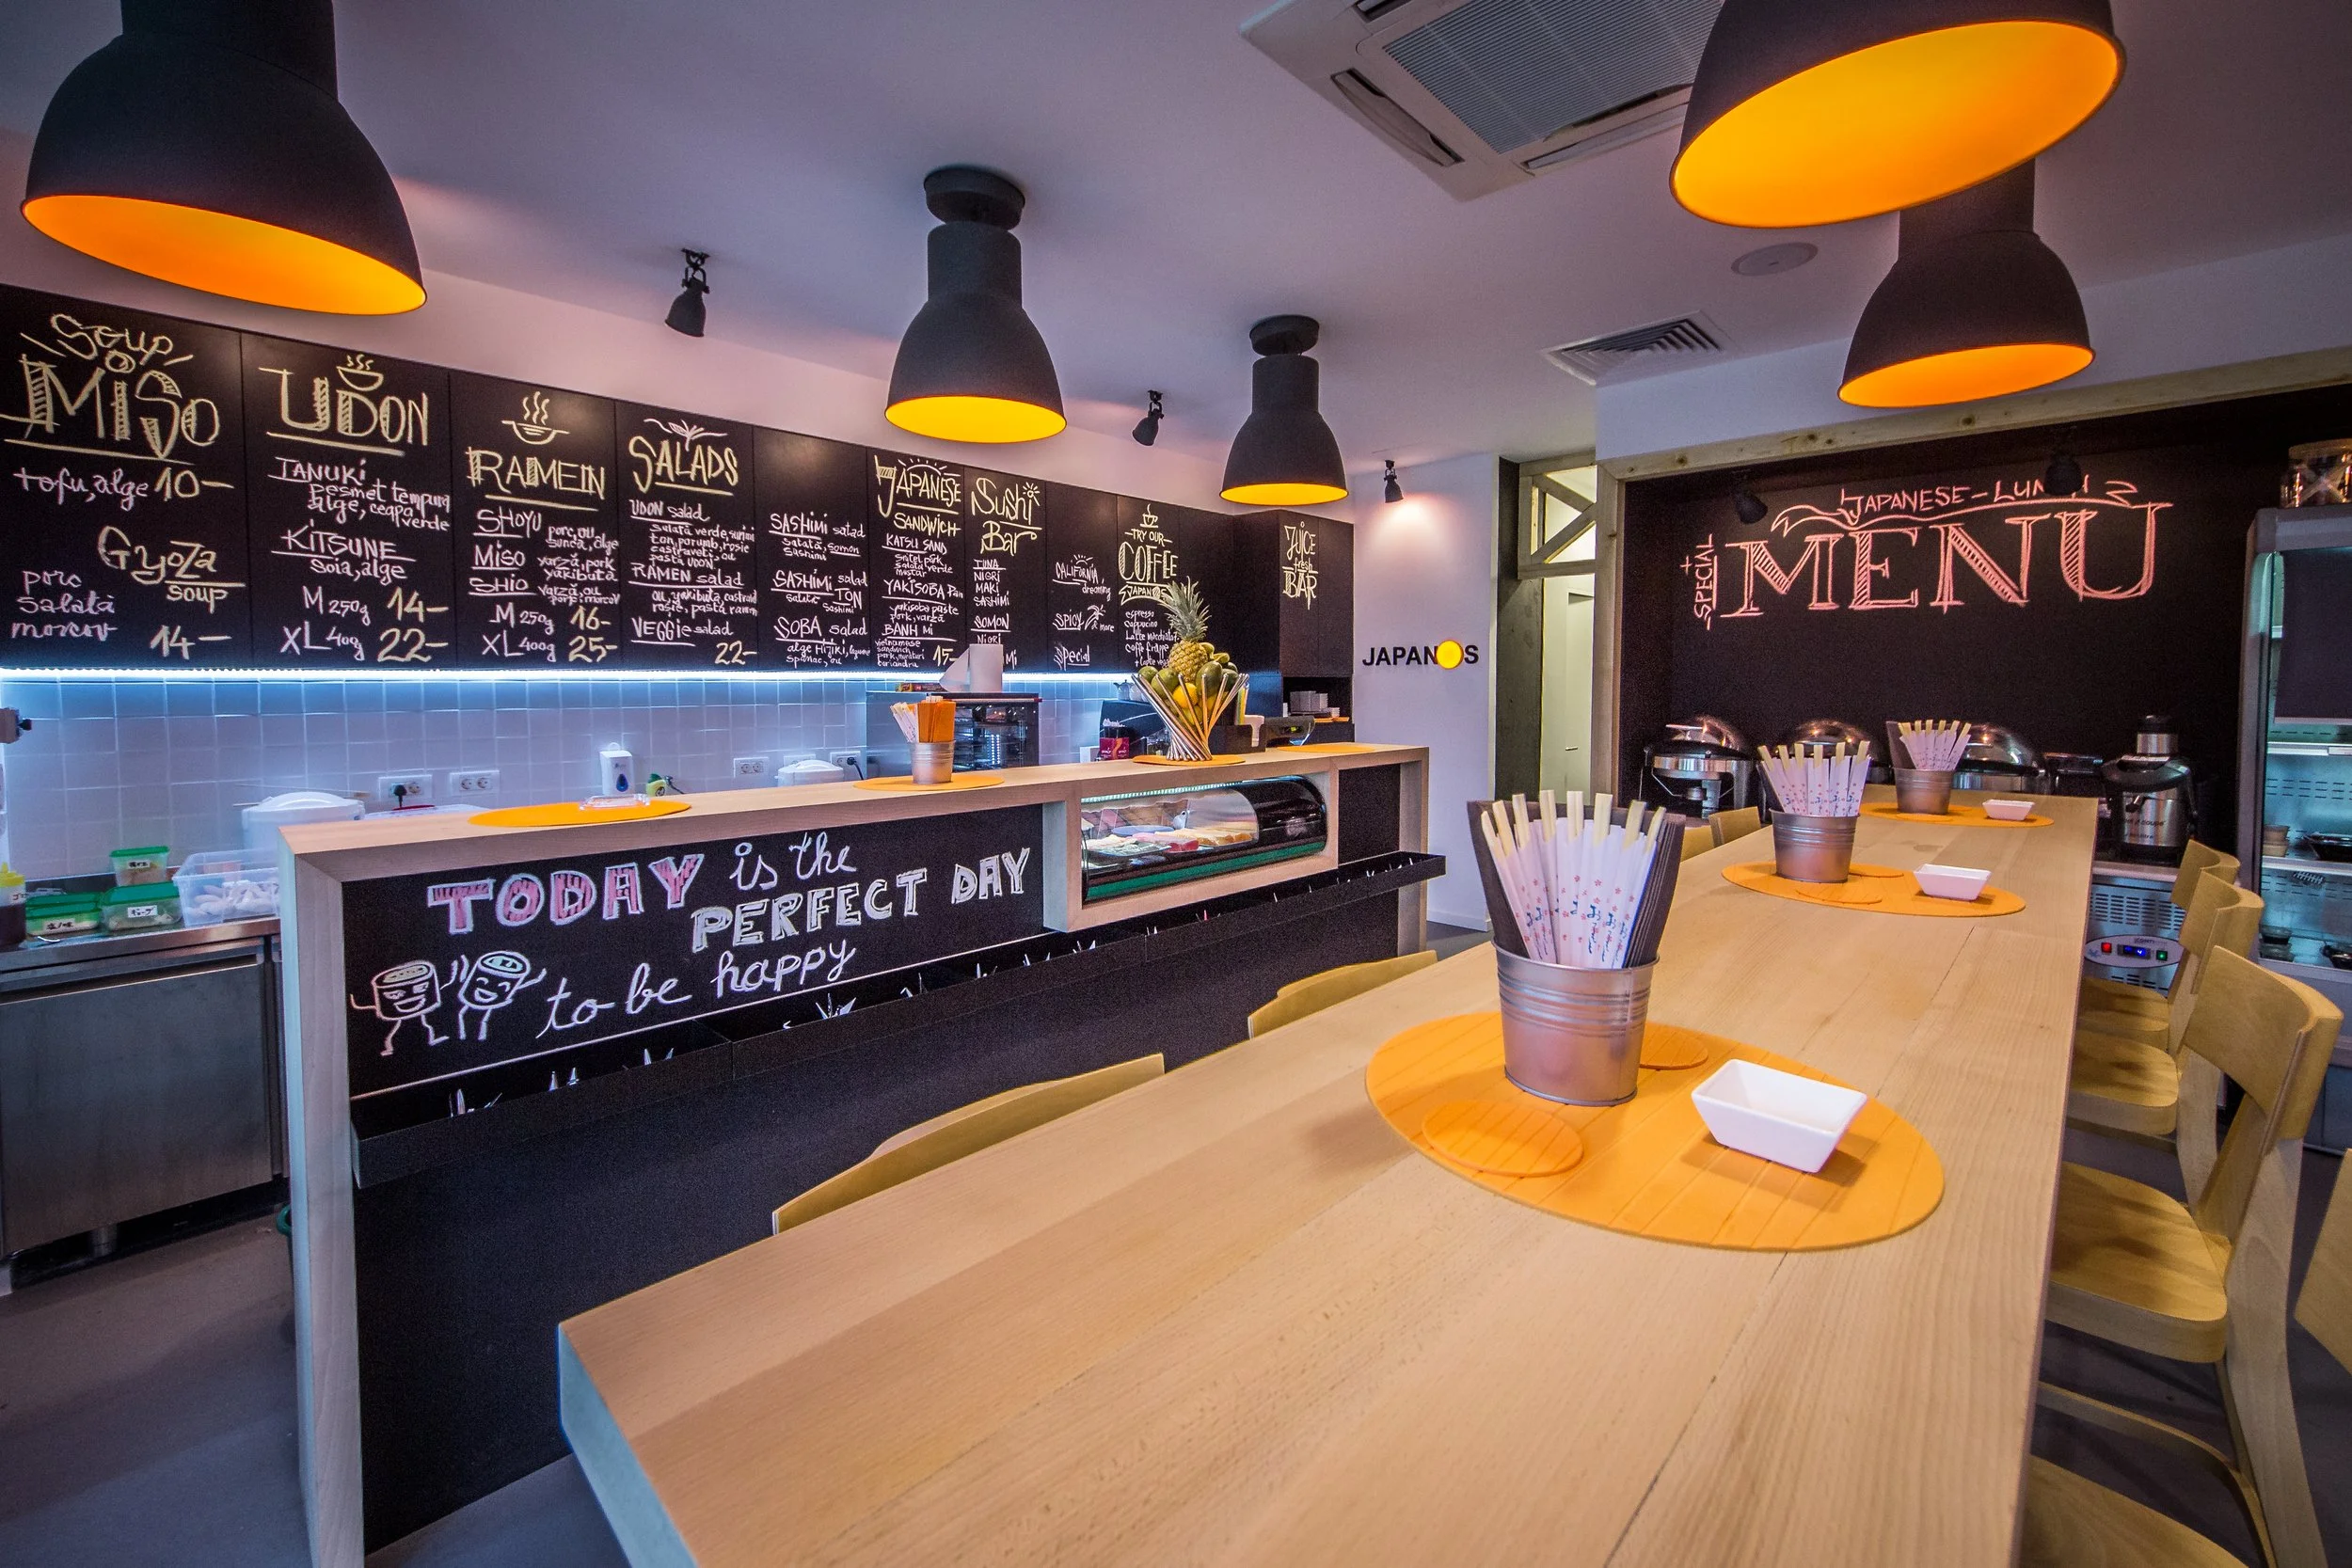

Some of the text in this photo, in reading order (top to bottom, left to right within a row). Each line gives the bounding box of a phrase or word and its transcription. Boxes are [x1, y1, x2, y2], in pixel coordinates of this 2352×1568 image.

[259, 368, 429, 446] UDON
[628, 436, 739, 494] SALADS
[874, 455, 961, 518] JAPANESE
[886, 532, 947, 555] KATSU SAND
[1119, 541, 1178, 583] COFFEE
[1721, 501, 2173, 617] MENU
[302, 586, 325, 614] M
[1282, 570, 1317, 610] BAR
[490, 602, 515, 628] M
[773, 616, 823, 639] SOBA
[882, 622, 918, 637] BANH
[280, 621, 332, 655] XL
[482, 629, 524, 657] XL
[427, 832, 858, 936] TODAY is the
[691, 847, 1031, 954] PERFECT DAY
[535, 939, 858, 1039] to be happy
